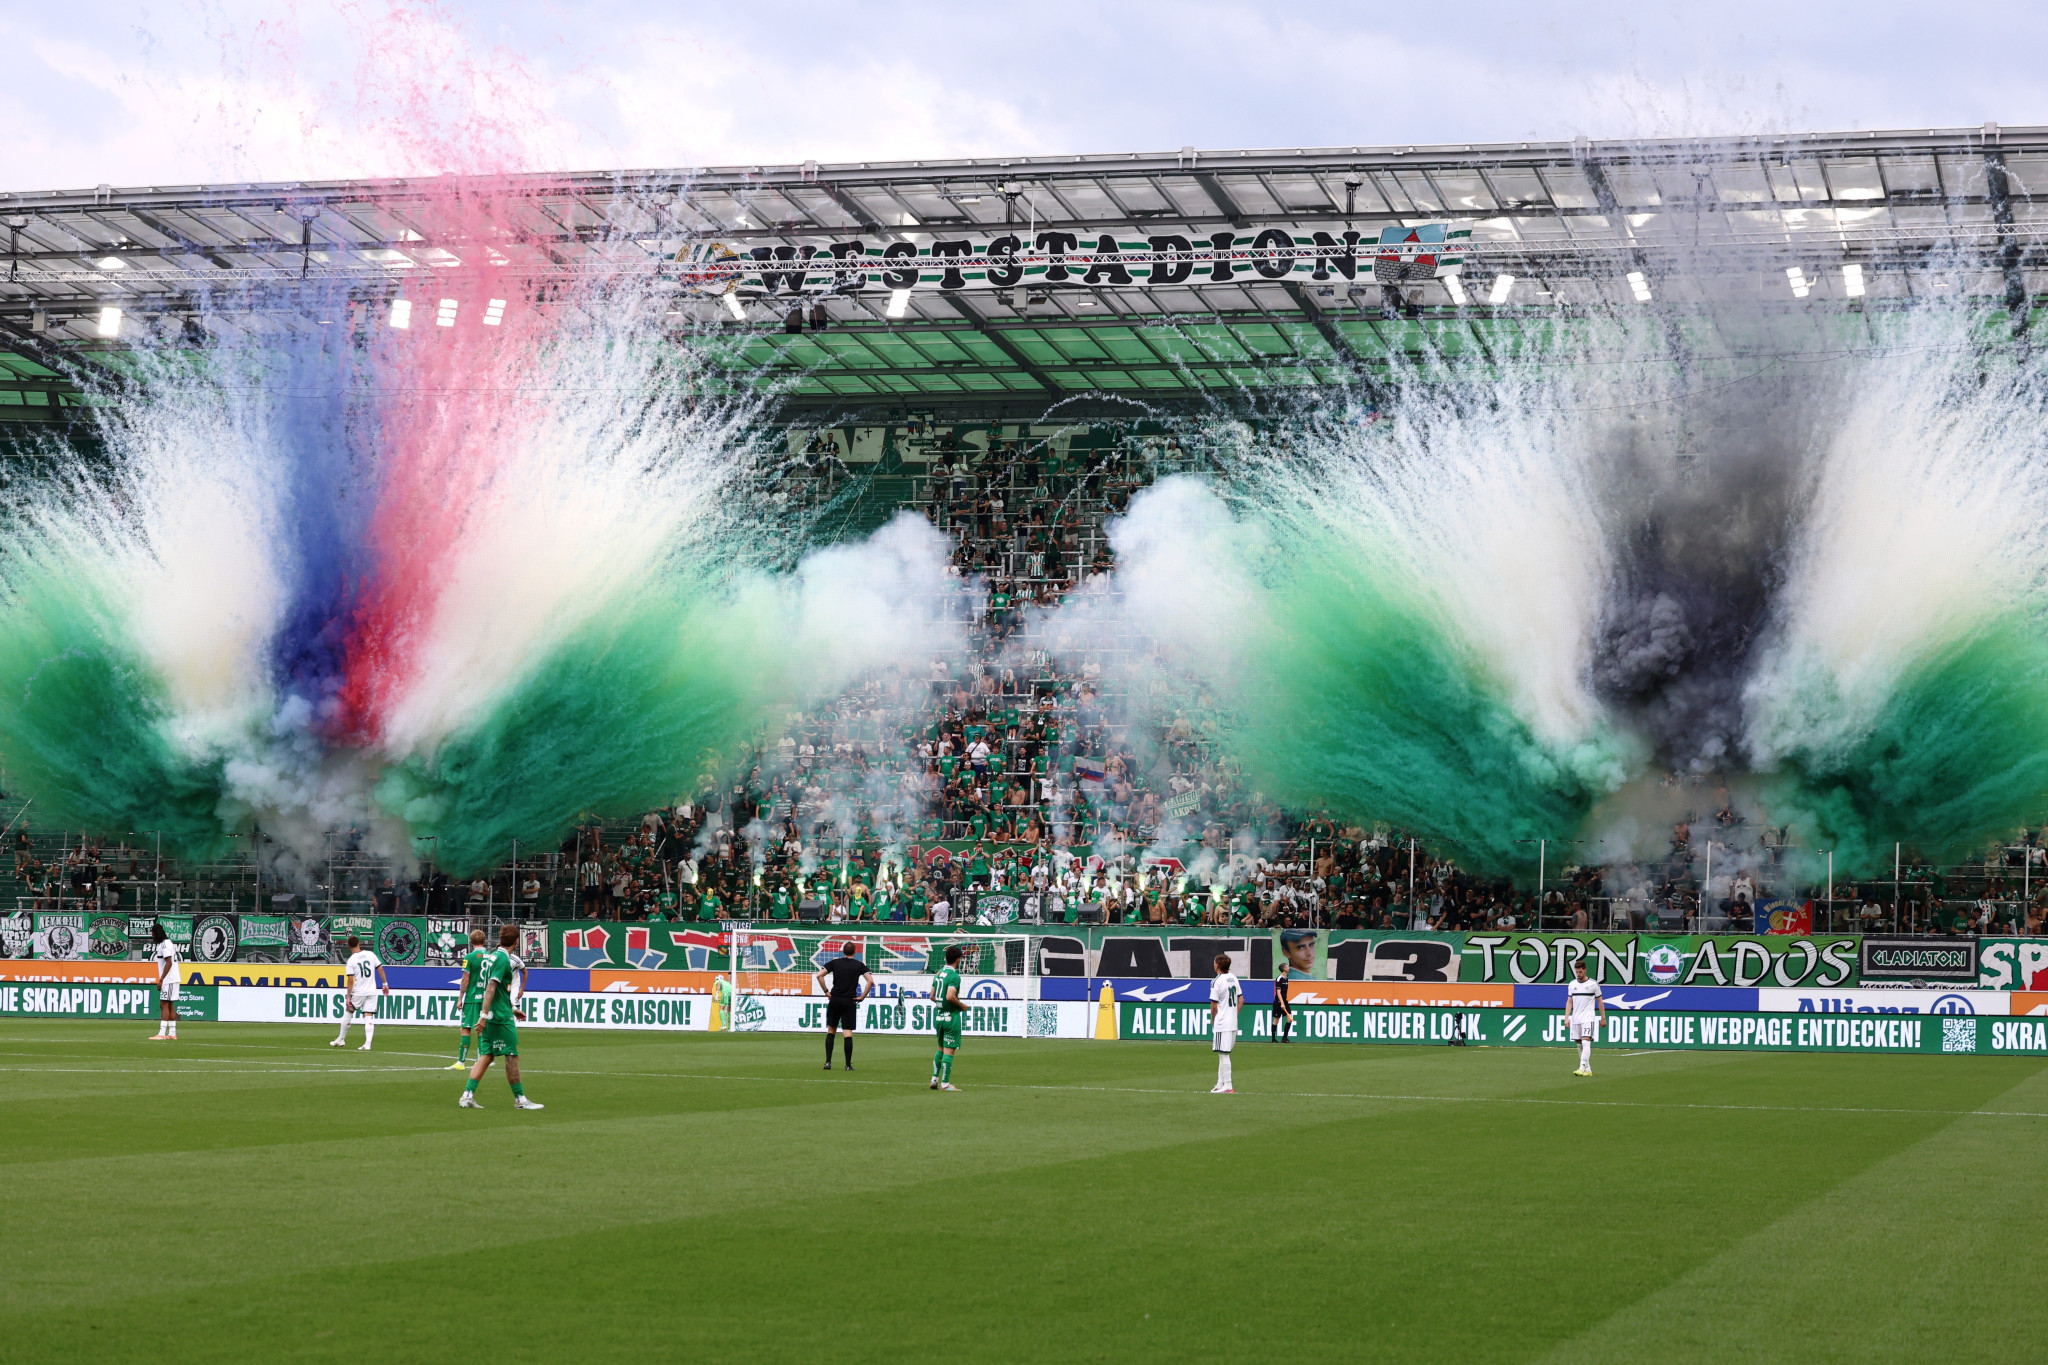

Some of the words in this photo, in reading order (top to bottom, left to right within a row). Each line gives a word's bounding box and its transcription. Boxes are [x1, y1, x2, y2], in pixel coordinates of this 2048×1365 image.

[333, 916, 373, 929] COLONOS
[427, 947, 453, 959] GATE
[1872, 950, 1967, 967] GLADIATORI
[357, 960, 371, 978] 16
[0, 987, 19, 1012] IE
[22, 987, 103, 1014] SKRAPID
[105, 989, 150, 1014] APP!
[285, 993, 328, 1018] DEIN
[543, 998, 605, 1023] GANZE
[611, 999, 692, 1025] SAISON!
[865, 1004, 906, 1030] ABO
[1132, 1007, 1176, 1035] ALLE
[1303, 1010, 1358, 1038] TORE.
[1363, 1011, 1425, 1039] NEUER
[1608, 1016, 1639, 1043] DIE
[1645, 1016, 1694, 1044] NEUE
[1700, 1017, 1792, 1046] WEBPAGE
[1798, 1018, 1922, 1048] ENTDECKEN!
